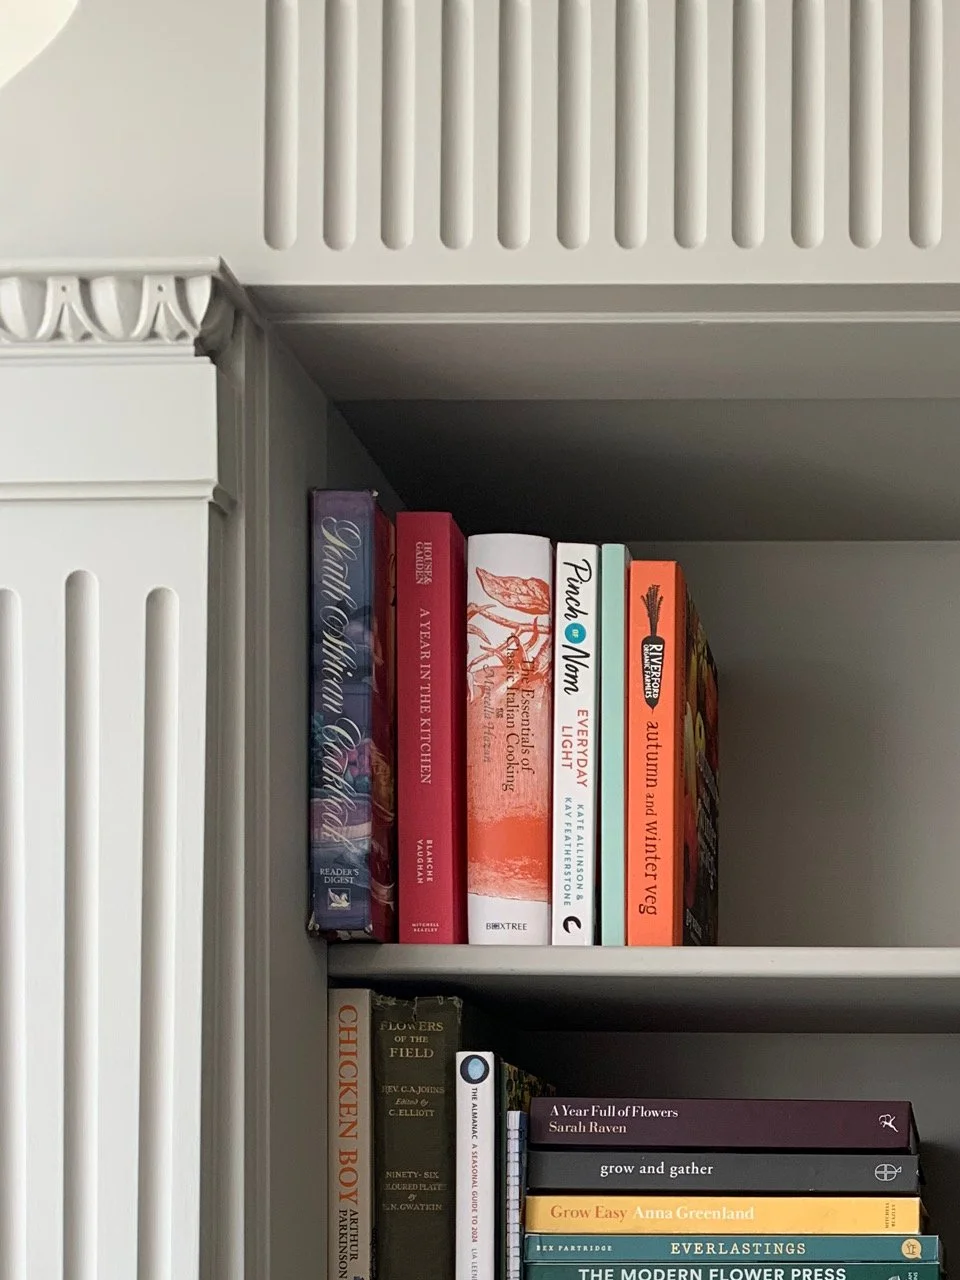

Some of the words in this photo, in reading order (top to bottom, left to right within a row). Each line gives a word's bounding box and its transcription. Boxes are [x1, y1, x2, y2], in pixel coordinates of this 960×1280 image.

[321, 517, 363, 600] South
[562, 558, 592, 621] Pinch
[420, 608, 431, 618] A
[572, 629, 579, 639] OF
[319, 603, 358, 714] African
[420, 620, 431, 660] YEAR
[506, 636, 520, 682] Classic
[420, 664, 431, 679] IN
[521, 657, 536, 684] The
[562, 645, 591, 696] Nom
[650, 643, 663, 700] RIVERFORD
[420, 683, 431, 713] THE
[506, 686, 520, 728] Italian
[520, 688, 536, 755] Essentials
[420, 717, 431, 785] KITCHEN
[502, 732, 520, 792] Cooking
[521, 758, 536, 774] of
[561, 725, 573, 771] LIGHT
[575, 710, 590, 789] EVERYDAY
[646, 721, 663, 789] autumn
[320, 717, 363, 849] Cookbook
[645, 793, 658, 817] and
[564, 797, 572, 818] KAY
[576, 804, 584, 830] KATE
[564, 822, 573, 907] FEATHERSTONE
[576, 835, 585, 891] ALLINSON
[645, 821, 662, 881] winter
[639, 884, 659, 916] veg
[338, 1004, 359, 1140] CHICKEN
[549, 1121, 586, 1133] Sarah
[589, 1122, 627, 1133] Raven
[550, 1106, 560, 1117] A
[563, 1106, 590, 1117] Year
[592, 1106, 615, 1117] Full
[617, 1106, 631, 1117] of
[632, 1106, 679, 1118] Flowers
[338, 1149, 359, 1206] BOY
[600, 1163, 635, 1178] grow
[641, 1162, 665, 1175] and
[670, 1163, 714, 1178] gather
[349, 1209, 360, 1261] ARTHUR
[472, 1215, 478, 1224] TO
[550, 1205, 590, 1219] Grow
[595, 1205, 627, 1222] Easy
[633, 1205, 673, 1219] Anna
[676, 1206, 755, 1220] Greenland
[338, 1209, 349, 1279] PARKINSON
[671, 1243, 807, 1254] EVERLASTINGS
